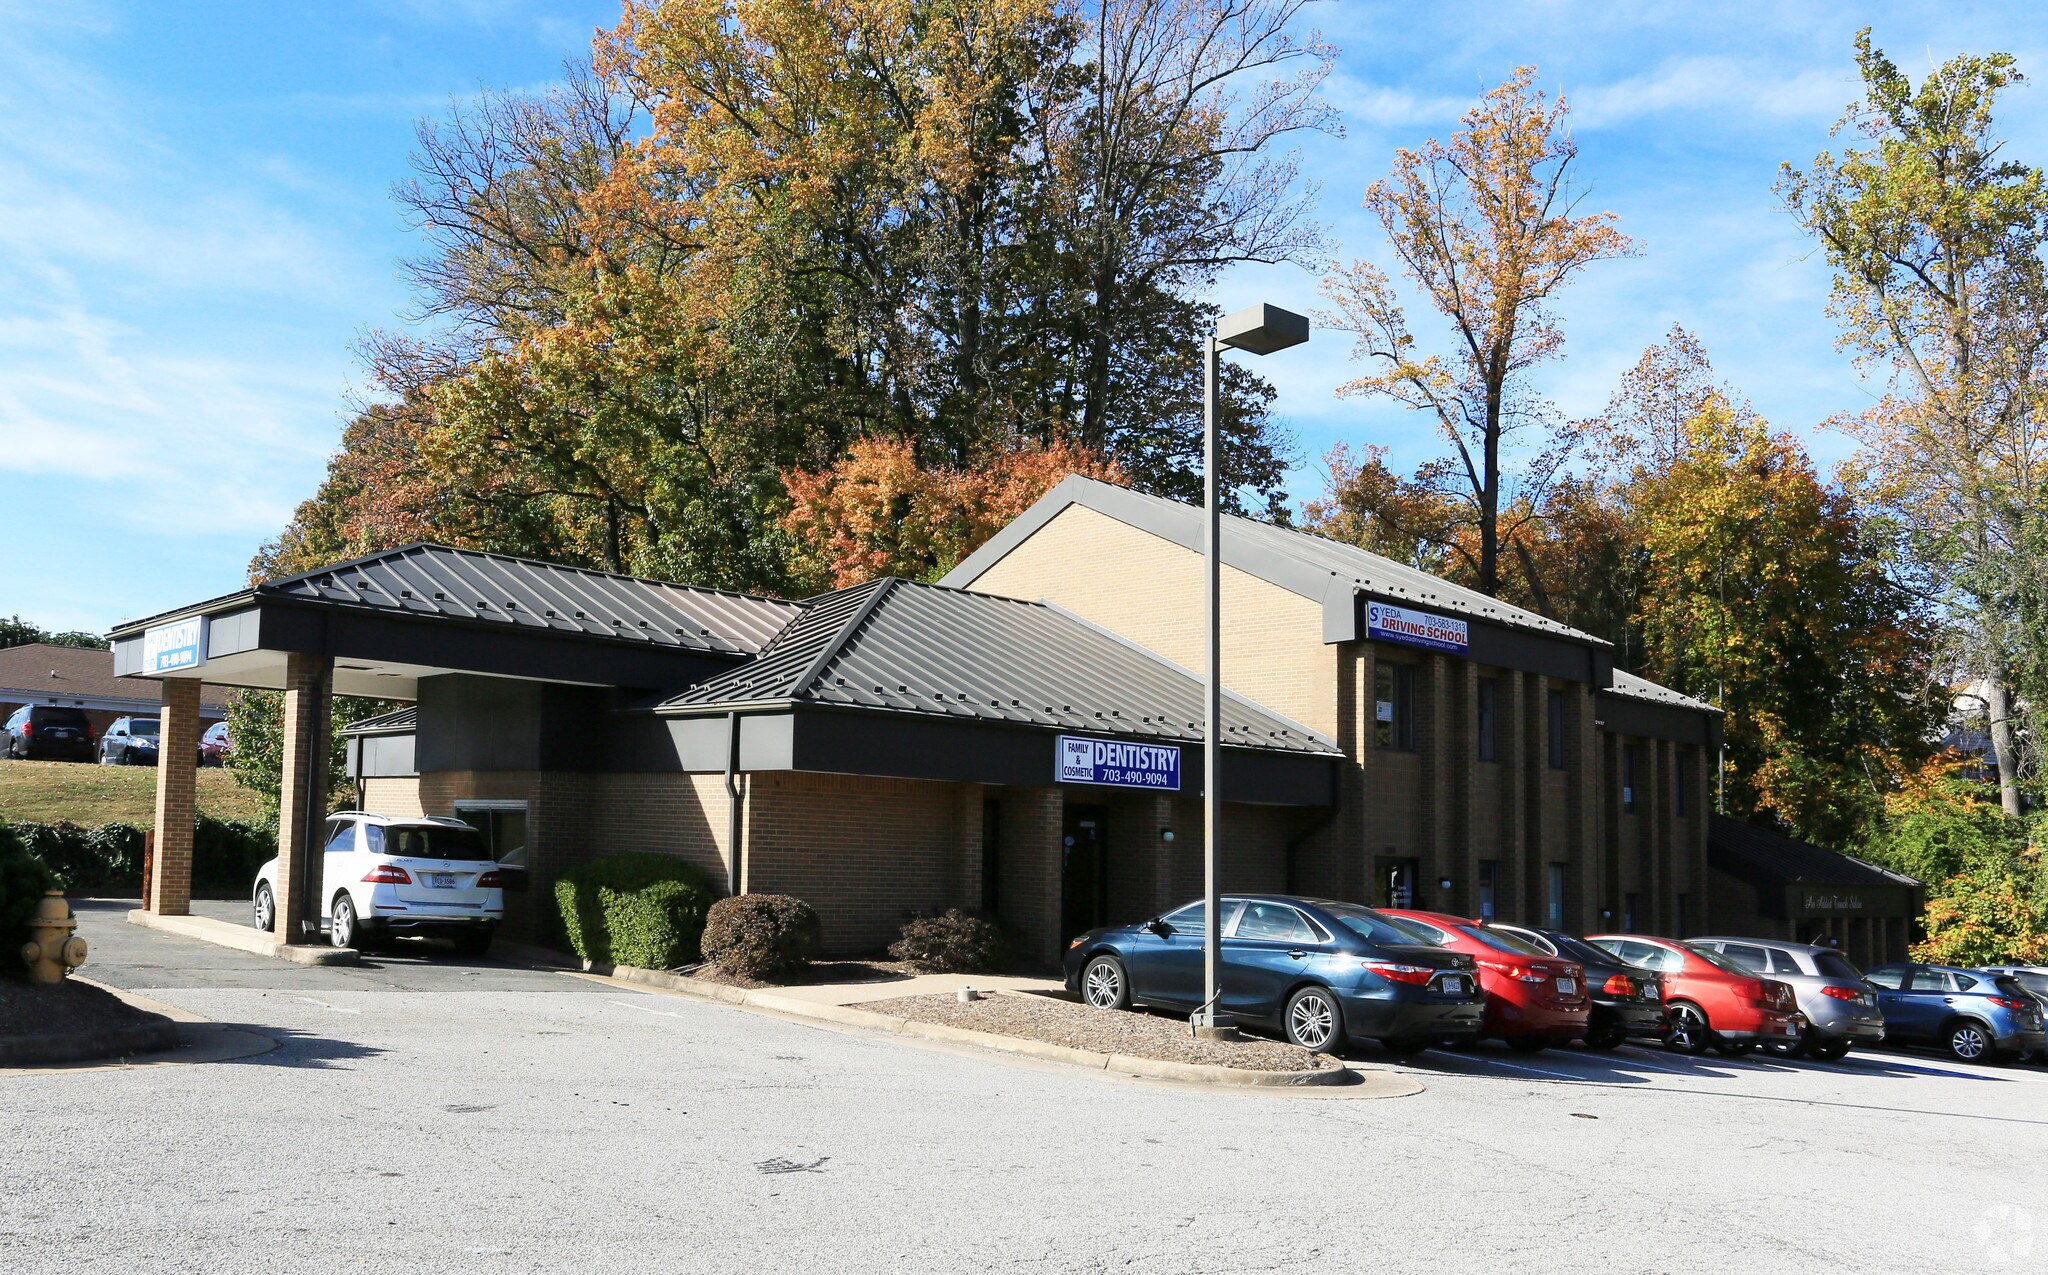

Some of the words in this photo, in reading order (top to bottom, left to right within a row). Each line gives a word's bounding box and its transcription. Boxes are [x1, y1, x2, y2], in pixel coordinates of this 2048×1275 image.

[1381, 618, 1425, 636] DRIVING
[1426, 626, 1468, 644] SCHOOL
[1424, 615, 1466, 633] 703-583-1313
[158, 621, 198, 653] DENTISTRY
[1068, 742, 1089, 754] FAMILY
[1095, 742, 1177, 772] DENTISTRY
[1075, 755, 1081, 765] &
[1063, 765, 1093, 778] COSMETIC
[1102, 768, 1168, 786] 703-490-9094
